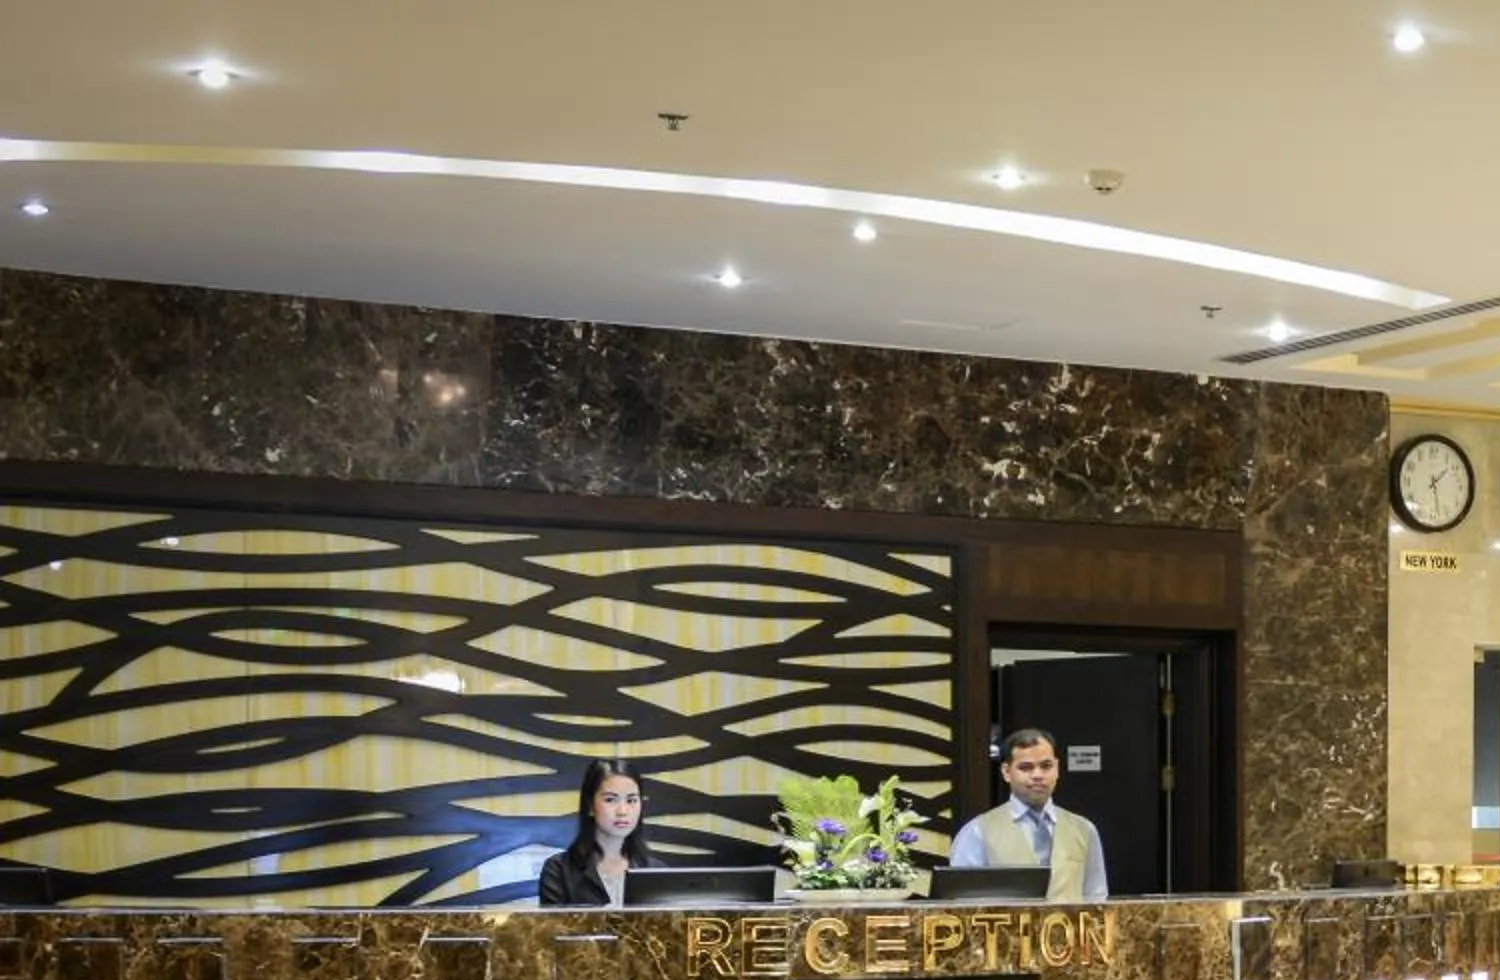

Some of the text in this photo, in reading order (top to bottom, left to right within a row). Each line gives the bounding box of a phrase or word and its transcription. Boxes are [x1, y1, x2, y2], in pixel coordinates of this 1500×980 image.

[1405, 554, 1457, 569] NEW YORK
[686, 911, 1116, 977] RECEPTION
